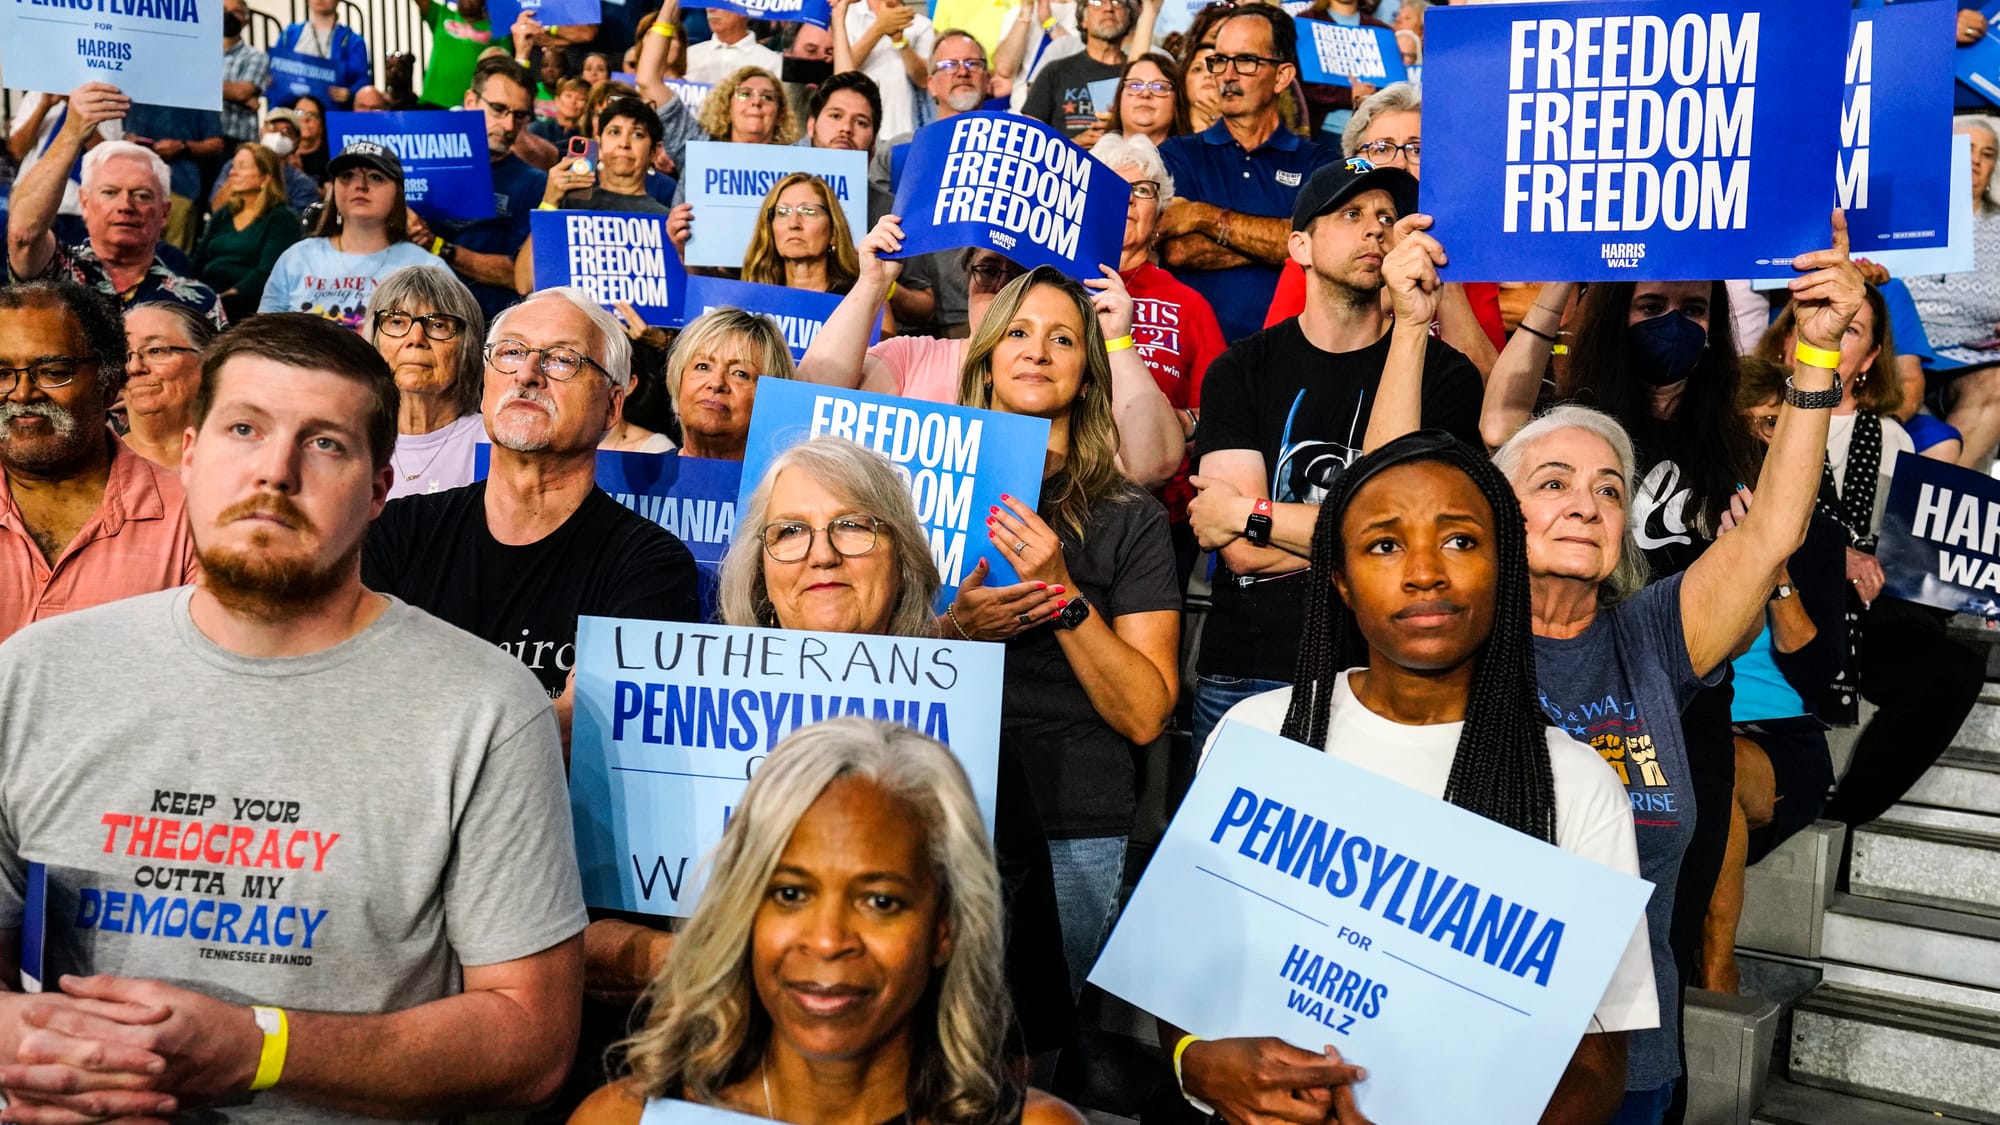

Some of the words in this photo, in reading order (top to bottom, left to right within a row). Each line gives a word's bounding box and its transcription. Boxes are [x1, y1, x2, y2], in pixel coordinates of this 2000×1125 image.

[16, 0, 200, 24] LVANIA
[94, 22, 113, 31] FOR
[1311, 22, 1377, 44] FREEDOM
[77, 37, 132, 60] HARRIS
[1315, 39, 1382, 61] FREEDOM
[1509, 12, 1760, 90] FREEDOM
[86, 58, 123, 71] WALZ
[1319, 57, 1387, 78] FREEDOM
[1506, 86, 1756, 162] FREEDOM
[342, 132, 473, 160] SYLVANIA
[949, 117, 1092, 193] FREEDOM
[404, 178, 428, 193] RRIS
[405, 193, 424, 201] ALZ
[704, 168, 849, 201] PENNSIA
[940, 152, 1087, 225] FREEDOM
[1503, 159, 1750, 233] FREEDOM
[566, 215, 663, 248] FREEDOM
[933, 186, 1081, 261] FREEDOM
[989, 229, 1017, 247] HARRIS
[569, 245, 666, 277] FREEDOM
[1601, 243, 1646, 259] HARRIS
[1608, 259, 1639, 268] WALZ
[1163, 364, 1180, 379] win
[810, 395, 984, 475] FREEDOM
[614, 625, 959, 690] LUTHERANS
[1567, 711, 1579, 722] &
[1580, 695, 1638, 721] WAZ
[150, 789, 217, 816] KEEP
[232, 797, 301, 824] YOUR
[1630, 793, 1679, 812] RISE
[101, 813, 342, 873] THEOCRACY
[134, 865, 226, 896] OUTTA
[241, 875, 285, 900] MY
[1209, 786, 1566, 988] PENNSYLVANIA
[74, 887, 330, 950] DEMOCRACY
[1337, 926, 1373, 952] FOR
[198, 947, 266, 964] TENNESSEE
[269, 952, 313, 967] BRANDO
[1279, 944, 1389, 1020] HARRIS
[1287, 989, 1357, 1036] WALZ
